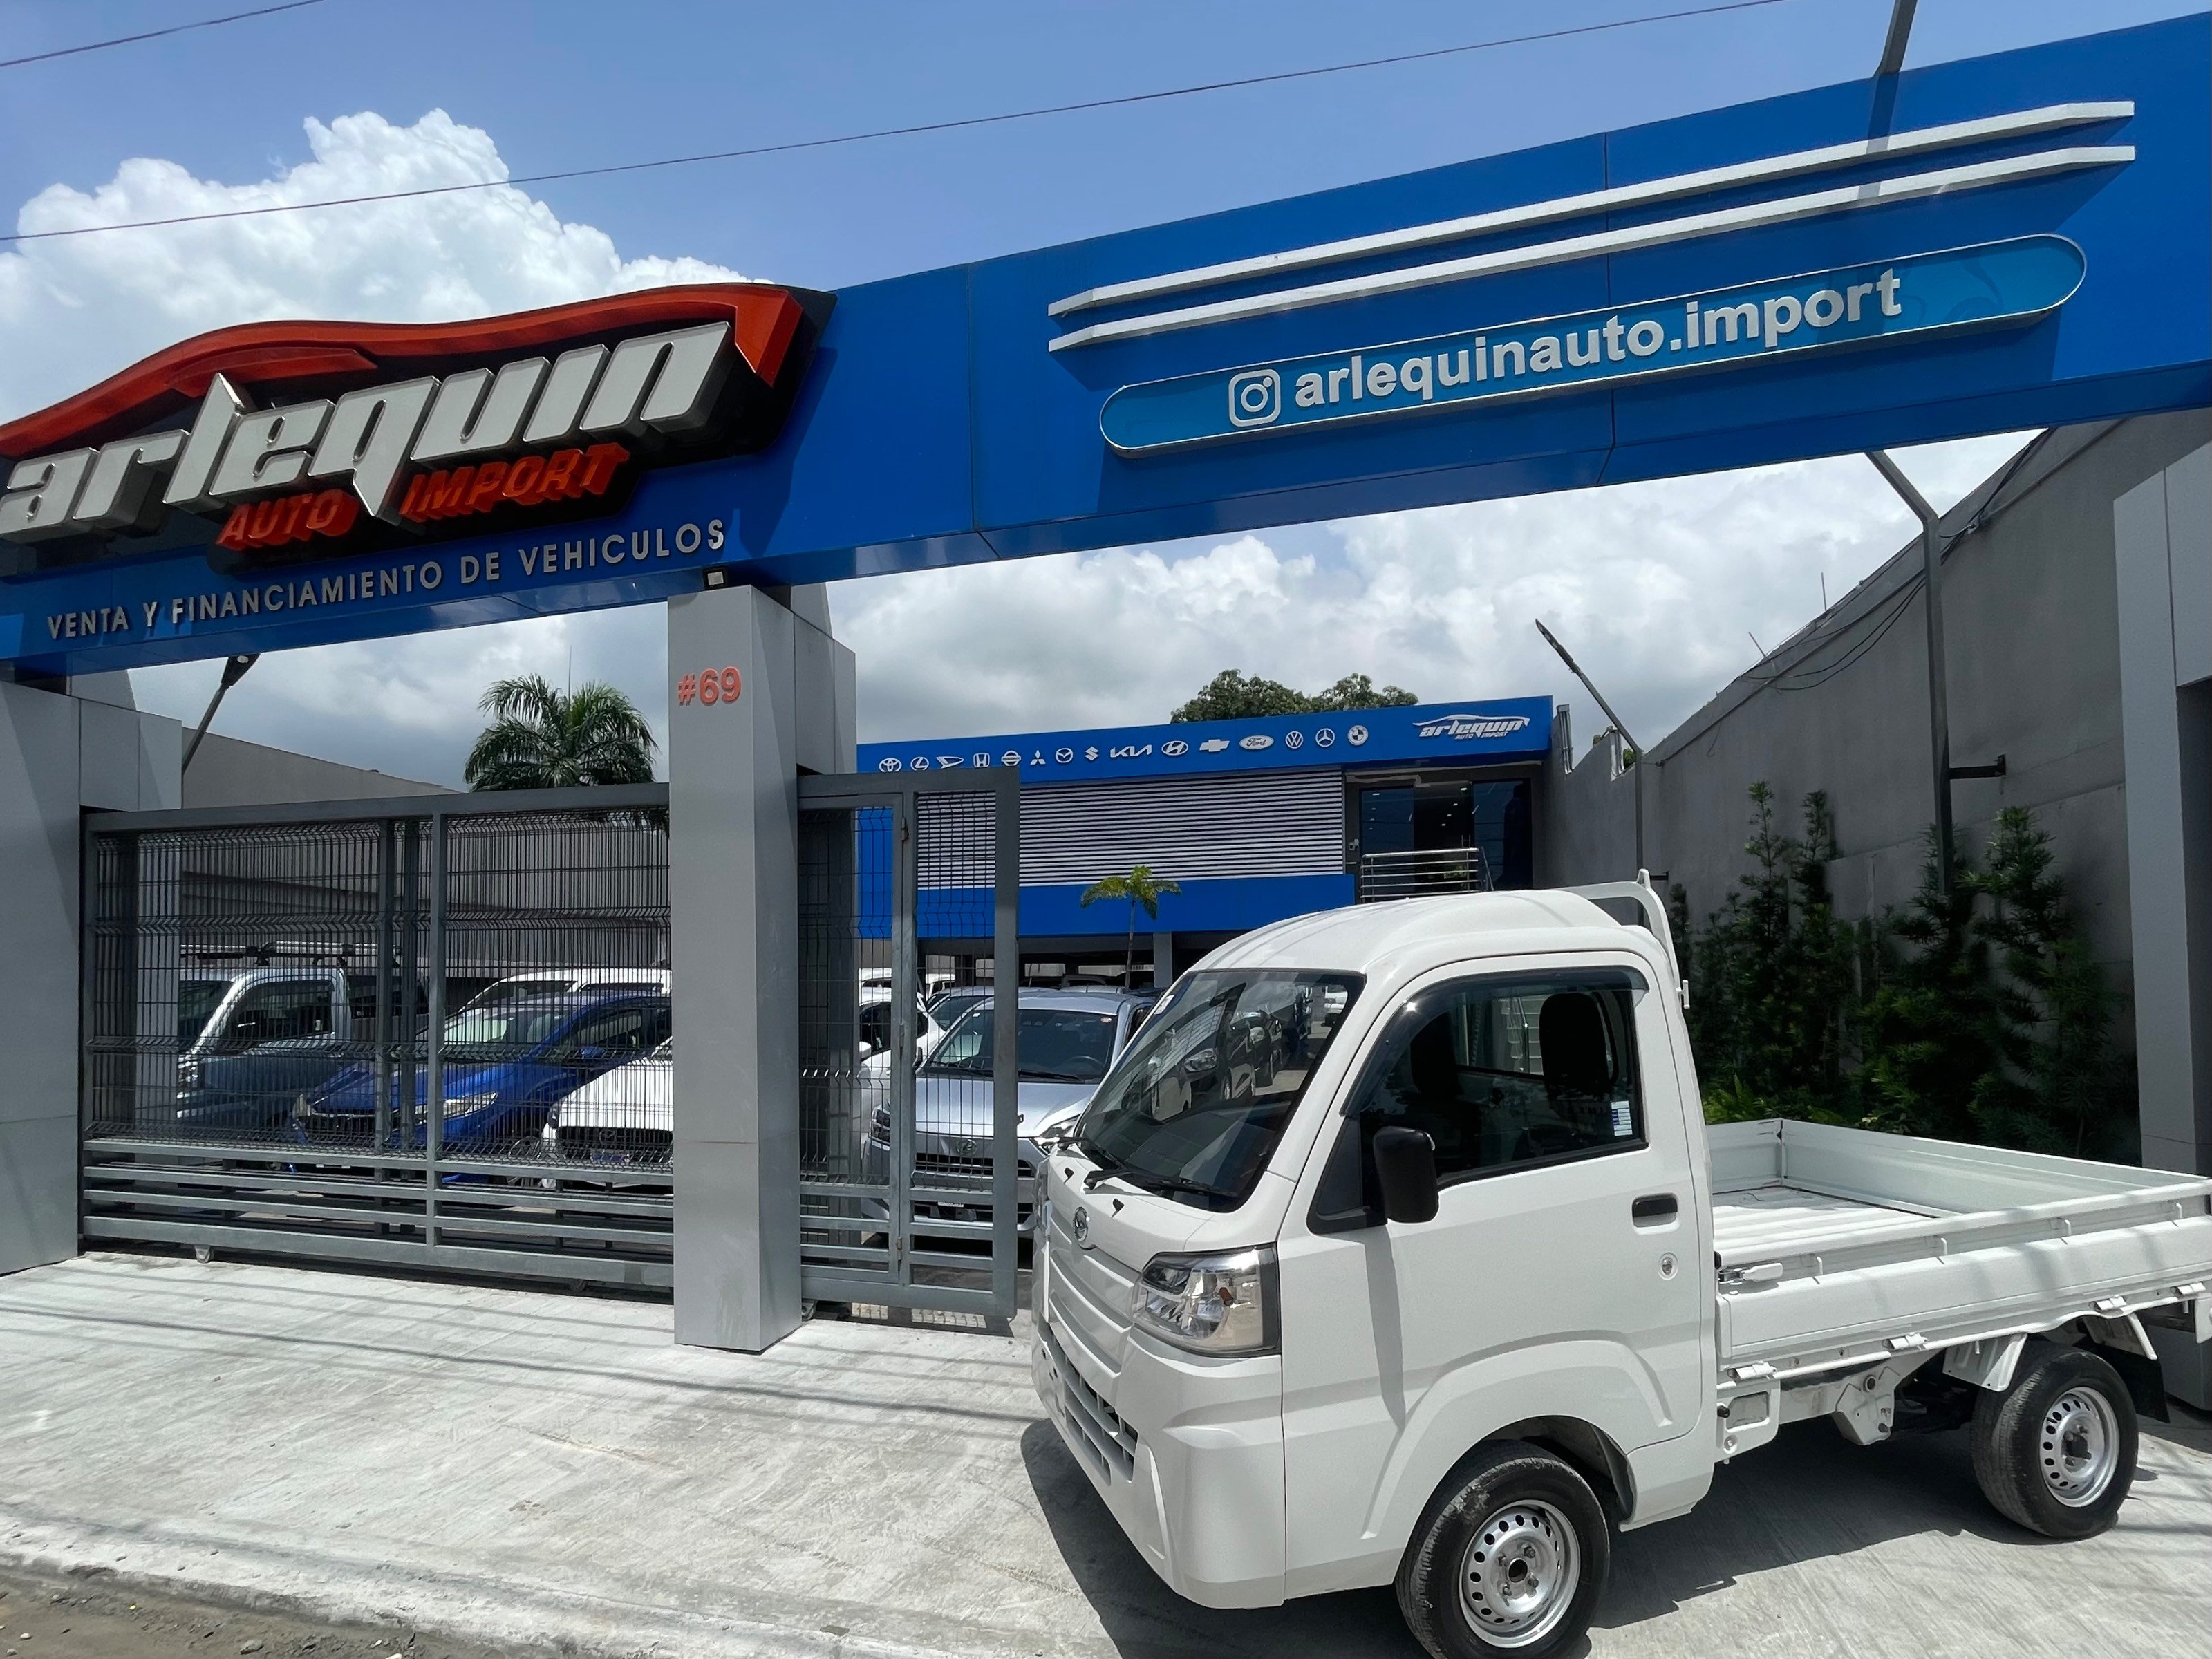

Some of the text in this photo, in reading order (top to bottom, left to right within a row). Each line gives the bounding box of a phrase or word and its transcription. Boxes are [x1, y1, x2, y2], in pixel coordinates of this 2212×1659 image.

[1294, 267, 1902, 409] arlequinauto.import
[0, 321, 732, 536] arlequin
[216, 442, 629, 550] AUTO IMPORT
[47, 518, 724, 640] VENTA Y FINANCIAMIENTO DE VEHICULOS
[677, 666, 742, 706] #69
[1418, 719, 1525, 738] arlequin
[1246, 737, 1267, 747] Ford
